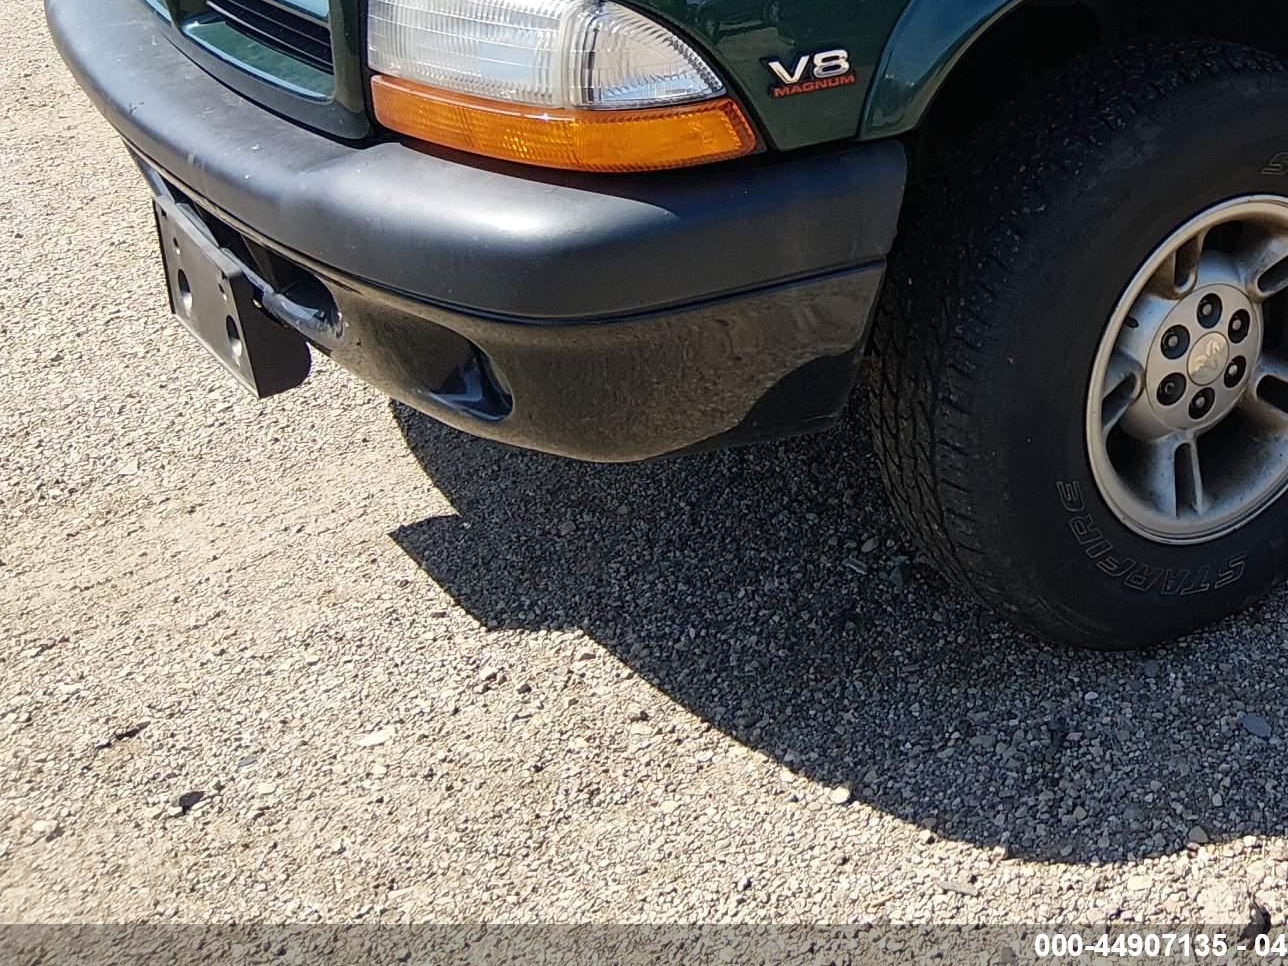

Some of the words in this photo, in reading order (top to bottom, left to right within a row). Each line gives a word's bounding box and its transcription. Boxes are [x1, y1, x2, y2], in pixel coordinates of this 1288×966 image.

[767, 49, 850, 85] V8
[774, 74, 856, 97] MAGNUM
[1056, 480, 1249, 596] STARFIRE
